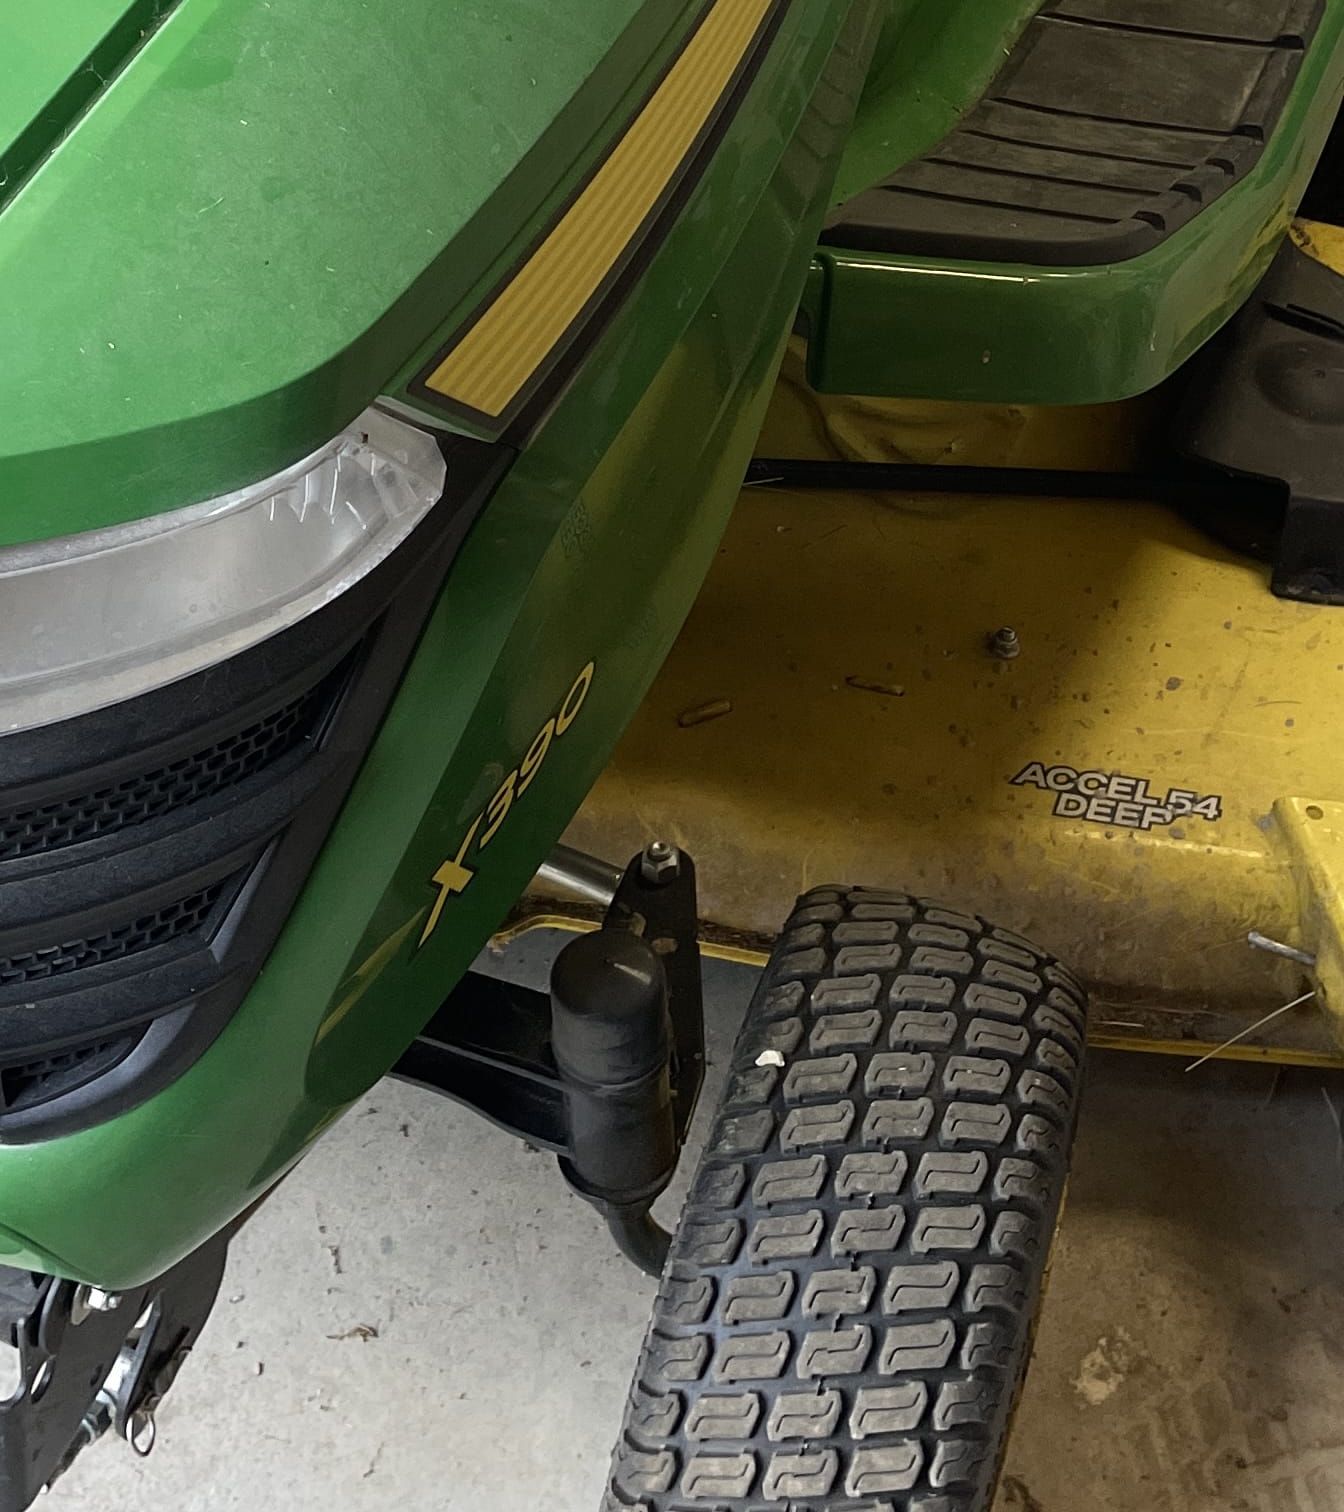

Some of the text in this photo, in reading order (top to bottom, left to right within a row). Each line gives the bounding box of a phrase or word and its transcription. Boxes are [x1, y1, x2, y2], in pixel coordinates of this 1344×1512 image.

[416, 660, 595, 950] X390
[1009, 761, 1222, 822] ACCEL 54
[1052, 791, 1174, 832] DEEP
